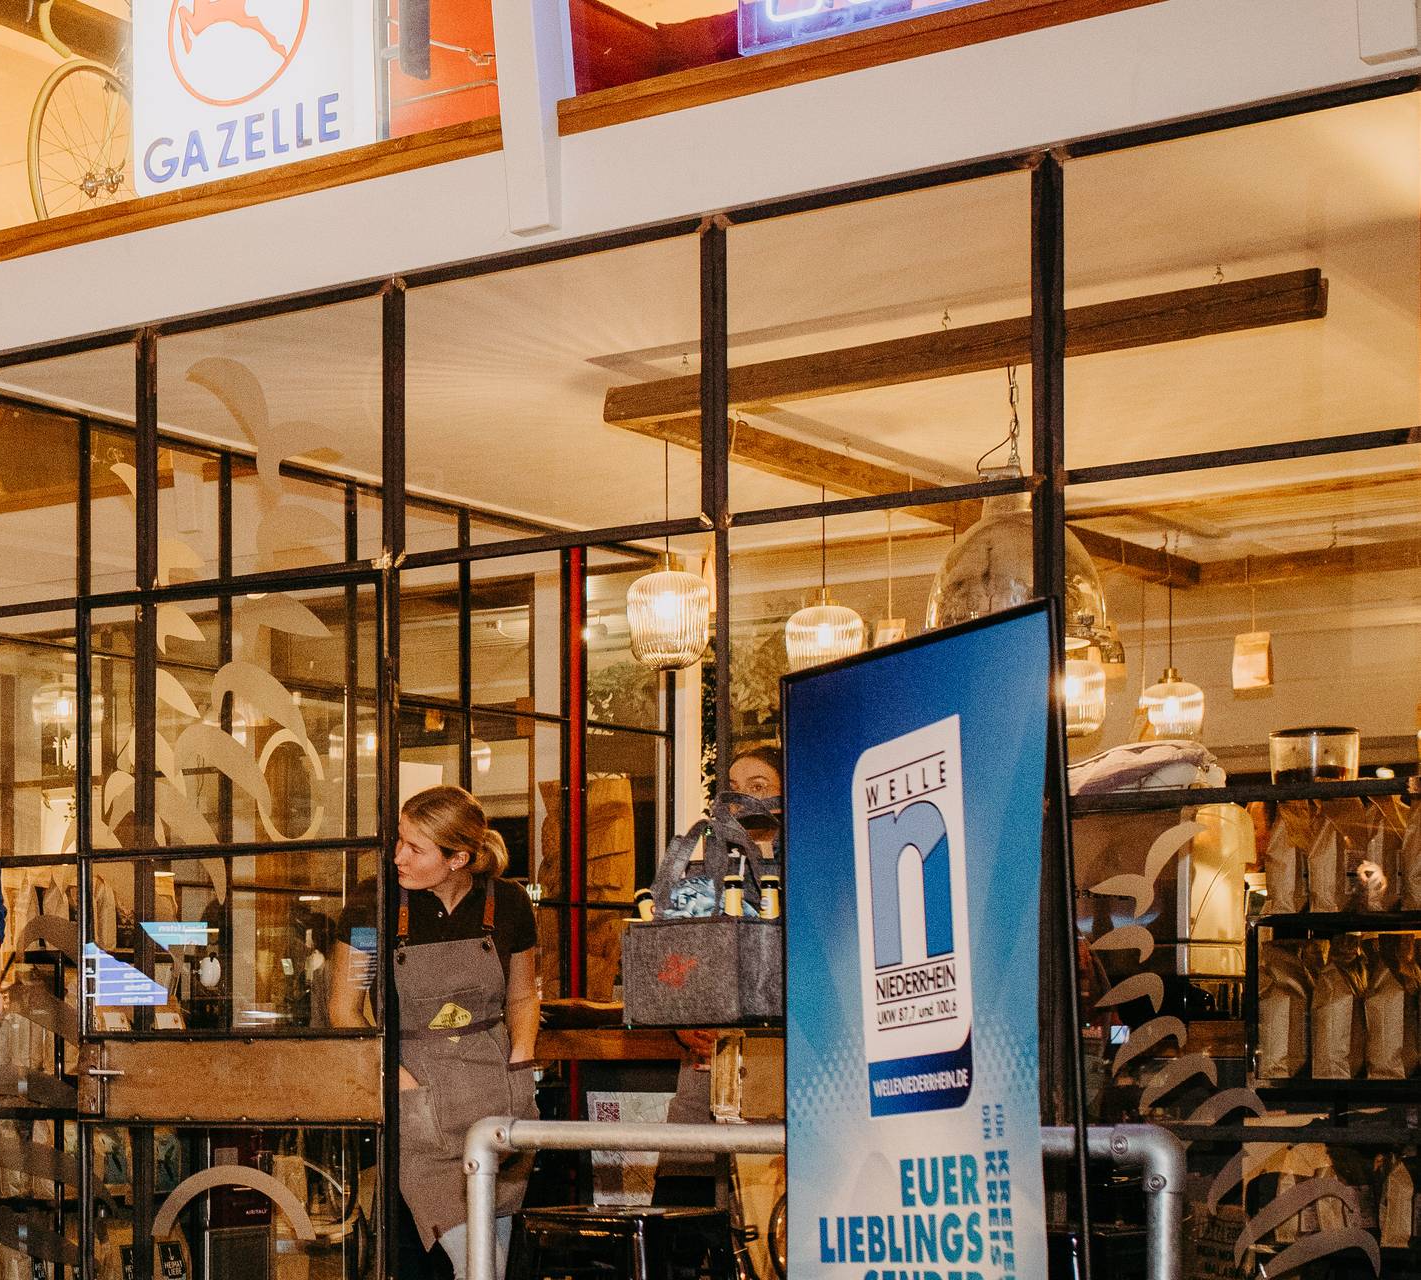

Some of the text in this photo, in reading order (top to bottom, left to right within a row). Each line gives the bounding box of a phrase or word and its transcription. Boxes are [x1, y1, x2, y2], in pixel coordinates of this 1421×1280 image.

[144, 92, 341, 184] GAZELLE
[865, 760, 946, 808] WELLE
[876, 963, 957, 1001] NIEDERRHEIN
[877, 1005, 896, 1025] UKW
[917, 1006, 934, 1018] und
[872, 1068, 969, 1097] WELLENIEDERRHEIN.DE
[899, 1154, 981, 1207] EUER
[984, 1150, 1003, 1266] KREIS
[818, 1212, 984, 1263] LIEBLINGS
